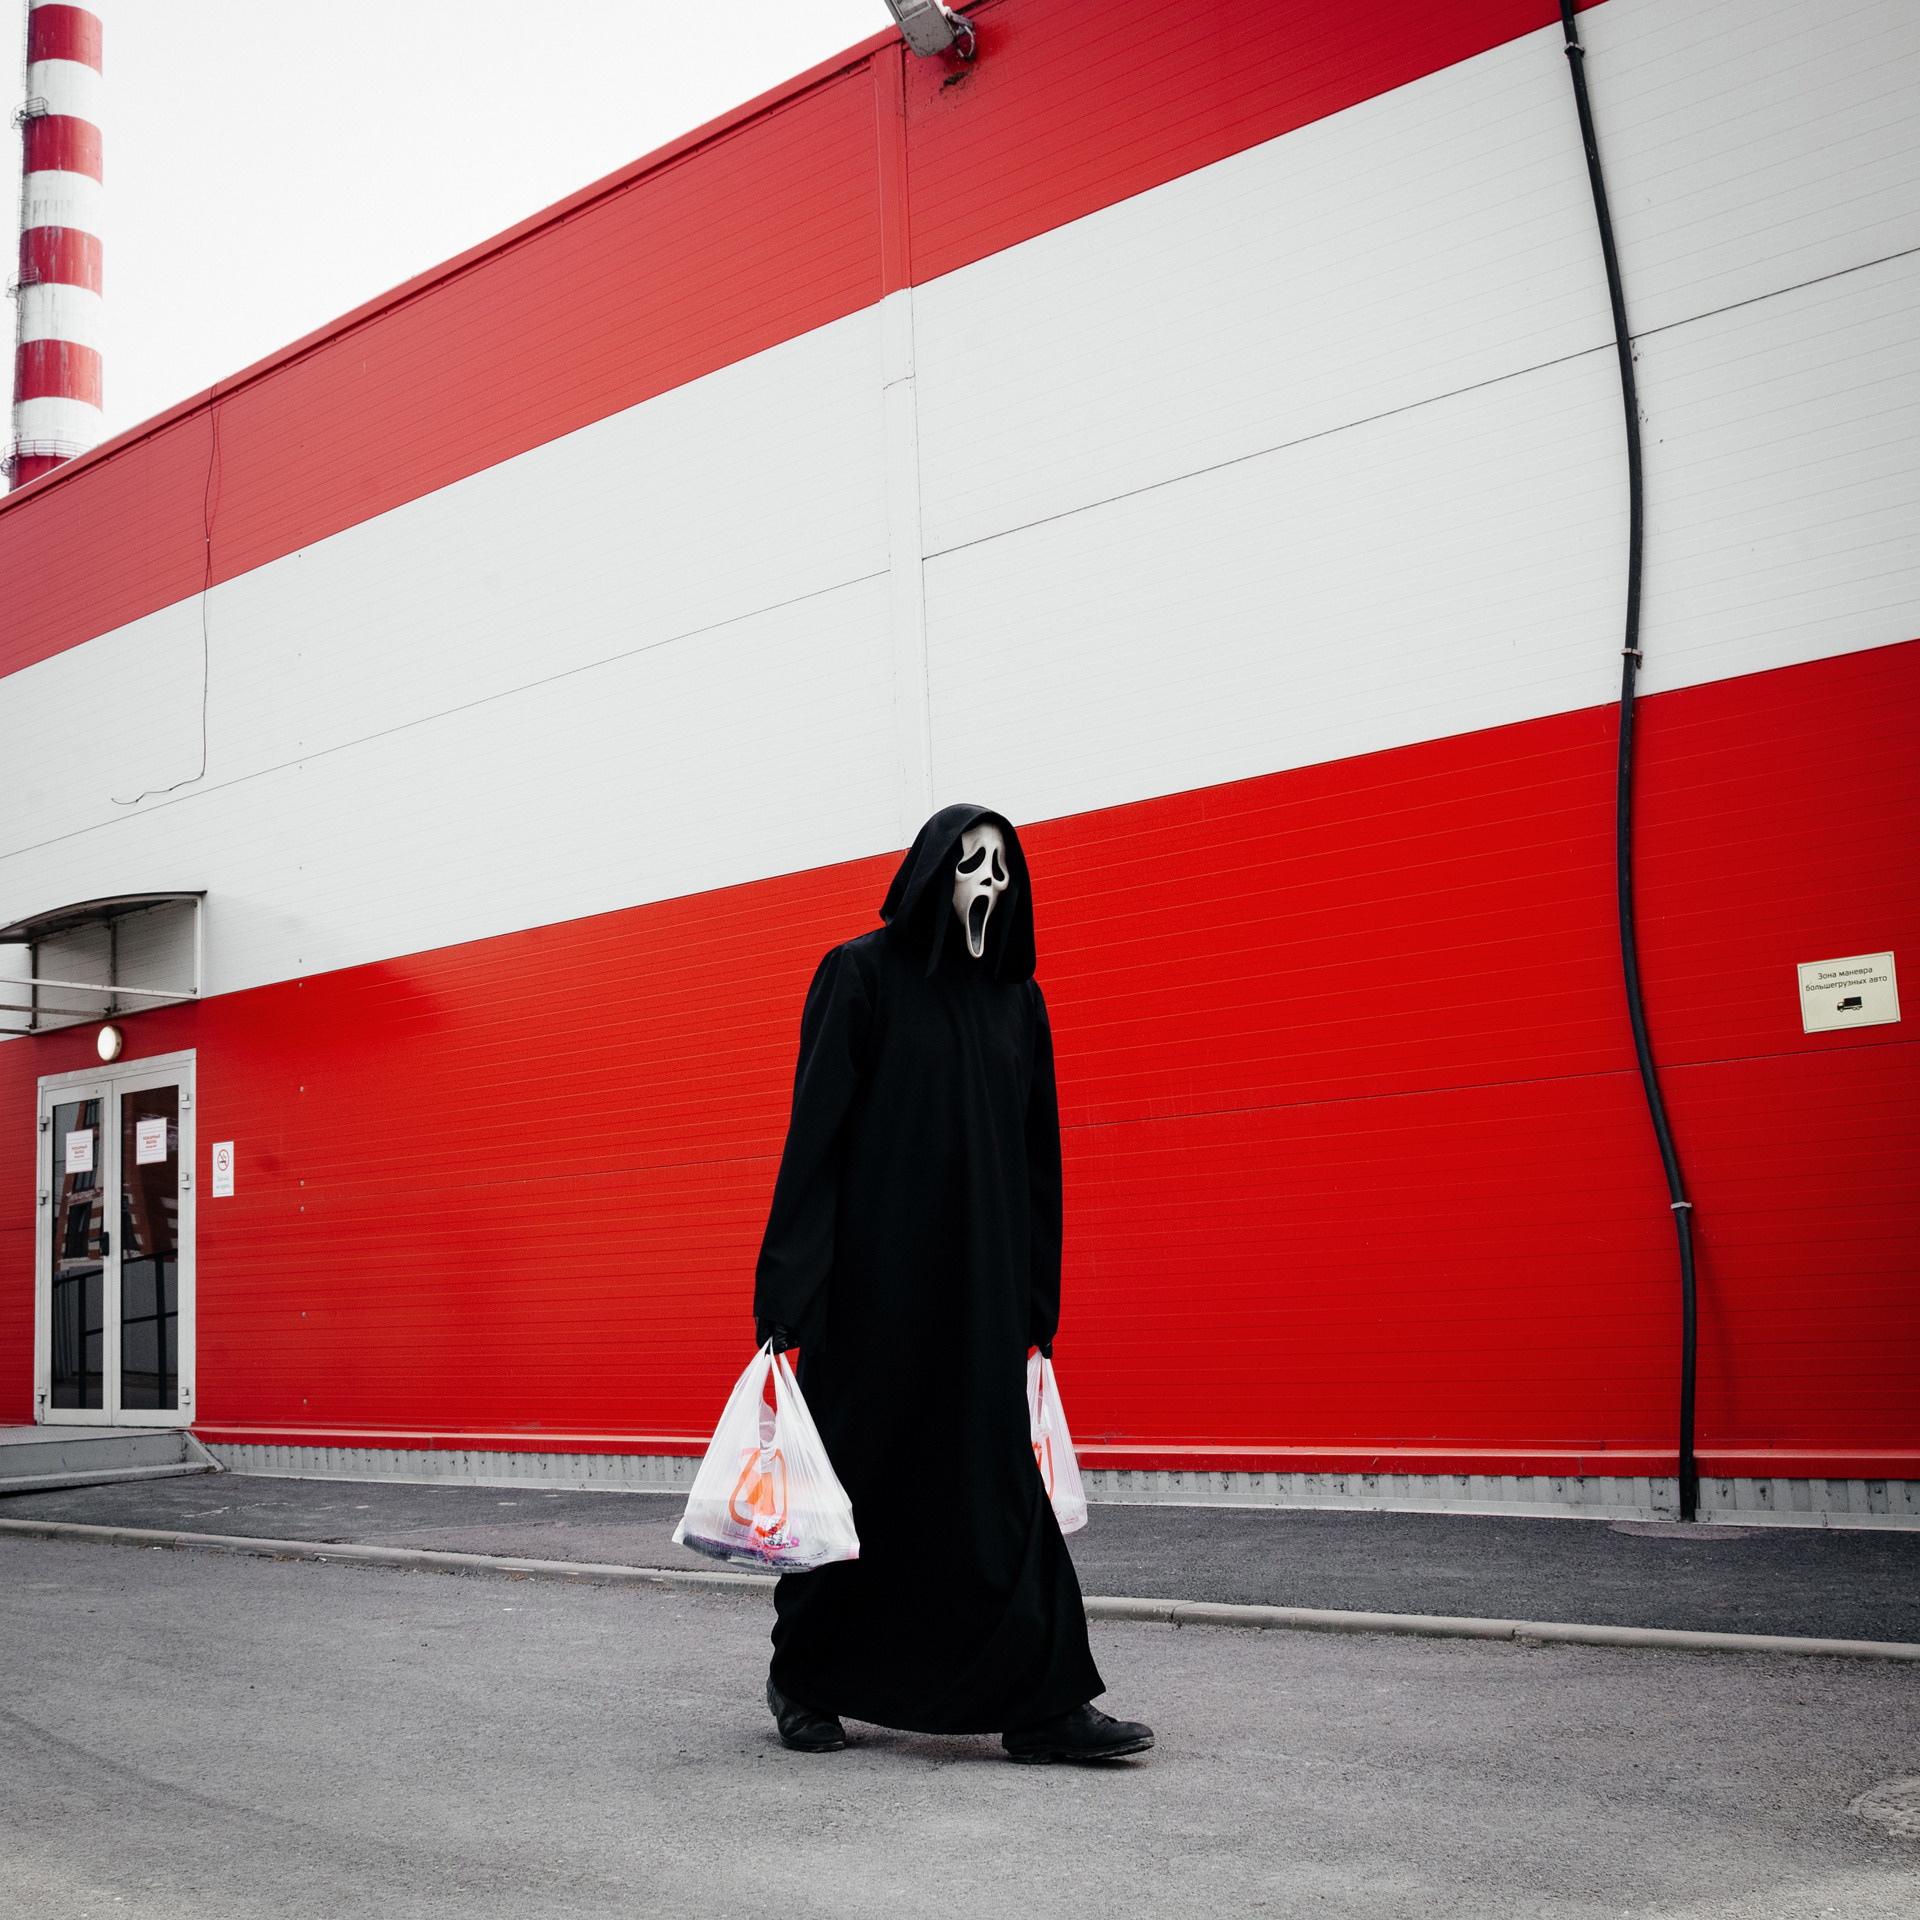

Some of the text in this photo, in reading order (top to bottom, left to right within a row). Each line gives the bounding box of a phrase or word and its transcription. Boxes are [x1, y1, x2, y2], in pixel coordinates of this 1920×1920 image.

[1818, 967, 1873, 980] Зона маневра
[1805, 975, 1888, 991] большегрузных авто
